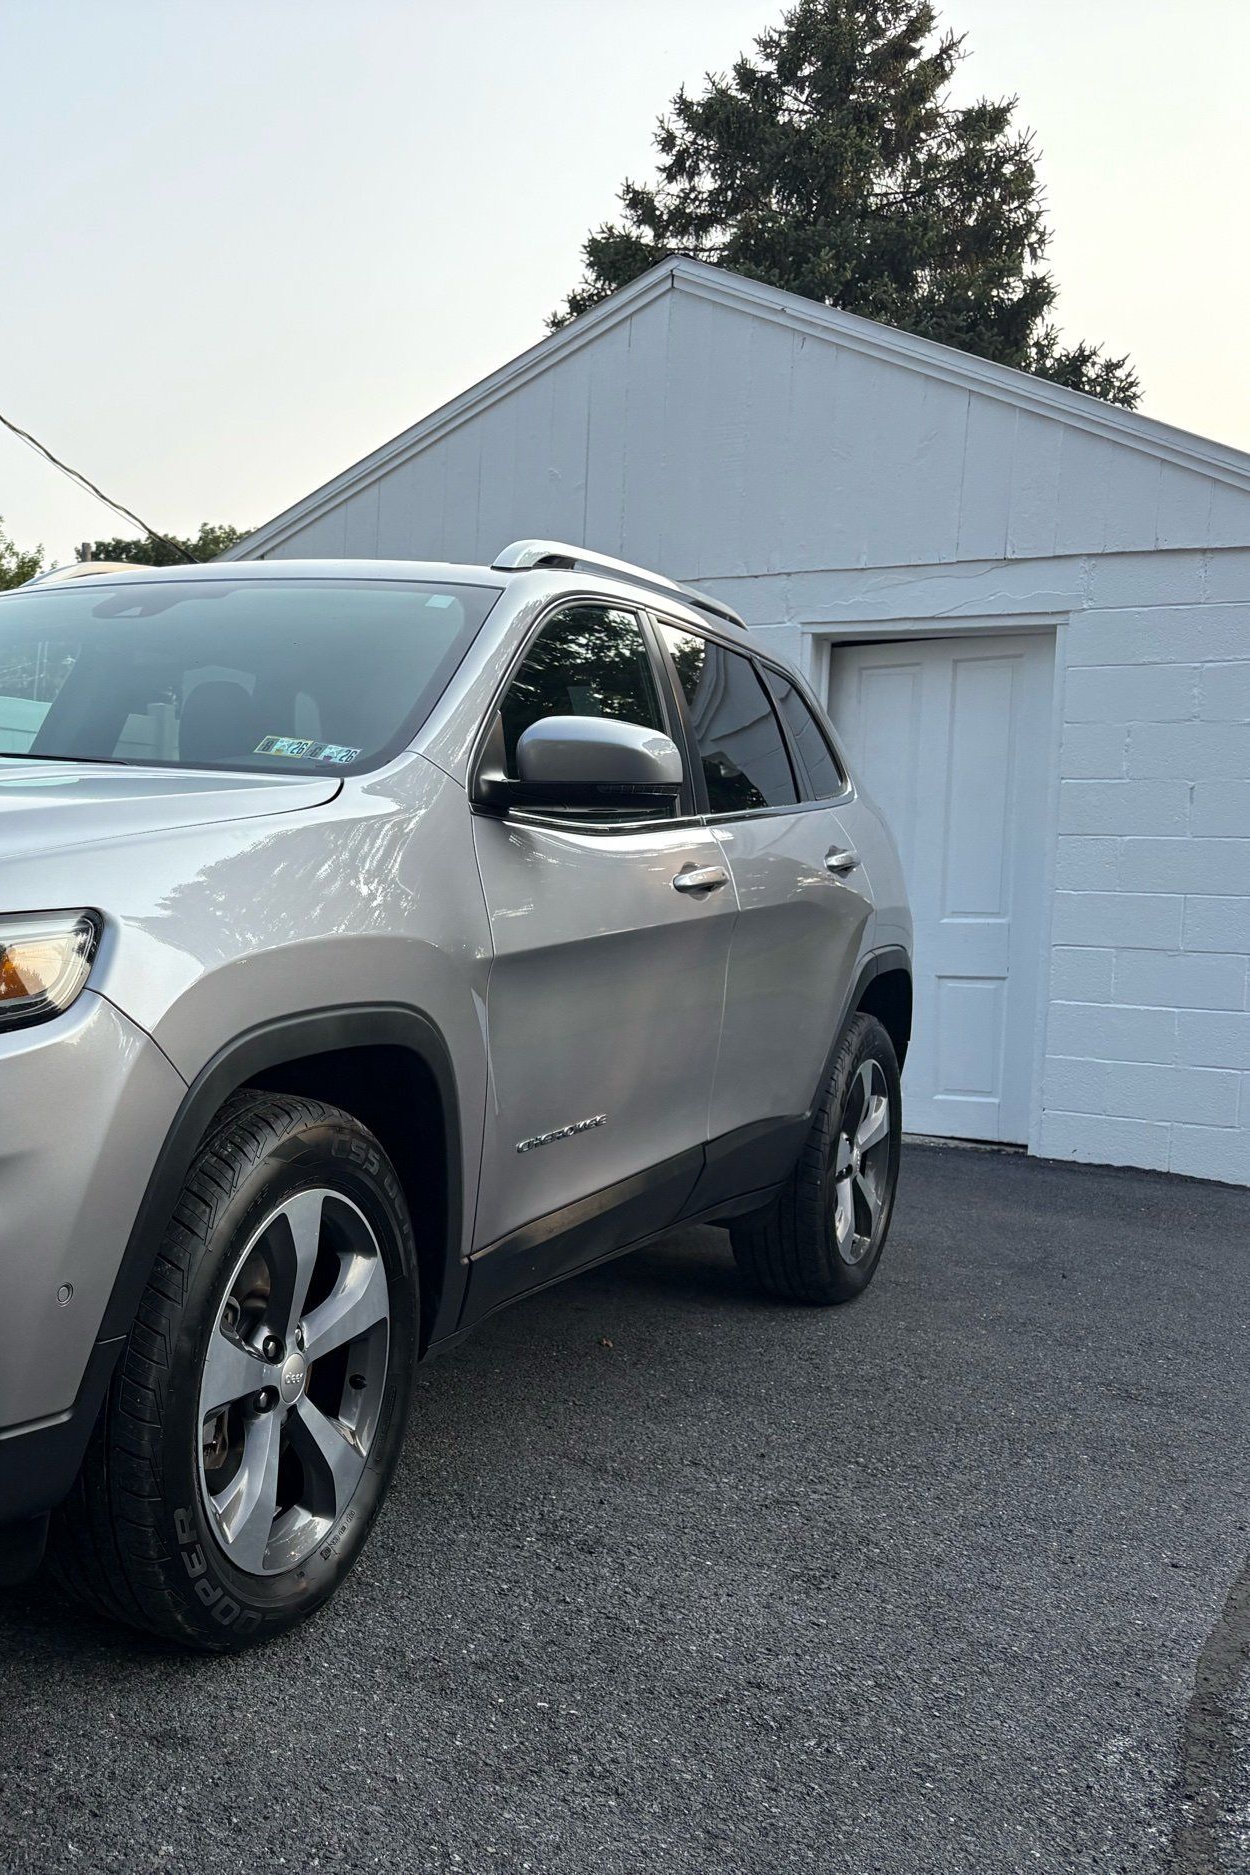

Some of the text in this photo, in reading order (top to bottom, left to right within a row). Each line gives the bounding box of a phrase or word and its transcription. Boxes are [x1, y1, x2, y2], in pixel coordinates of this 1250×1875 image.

[290, 741, 309, 755] 26
[338, 749, 358, 763] 26
[174, 1505, 276, 1634] OOPER
